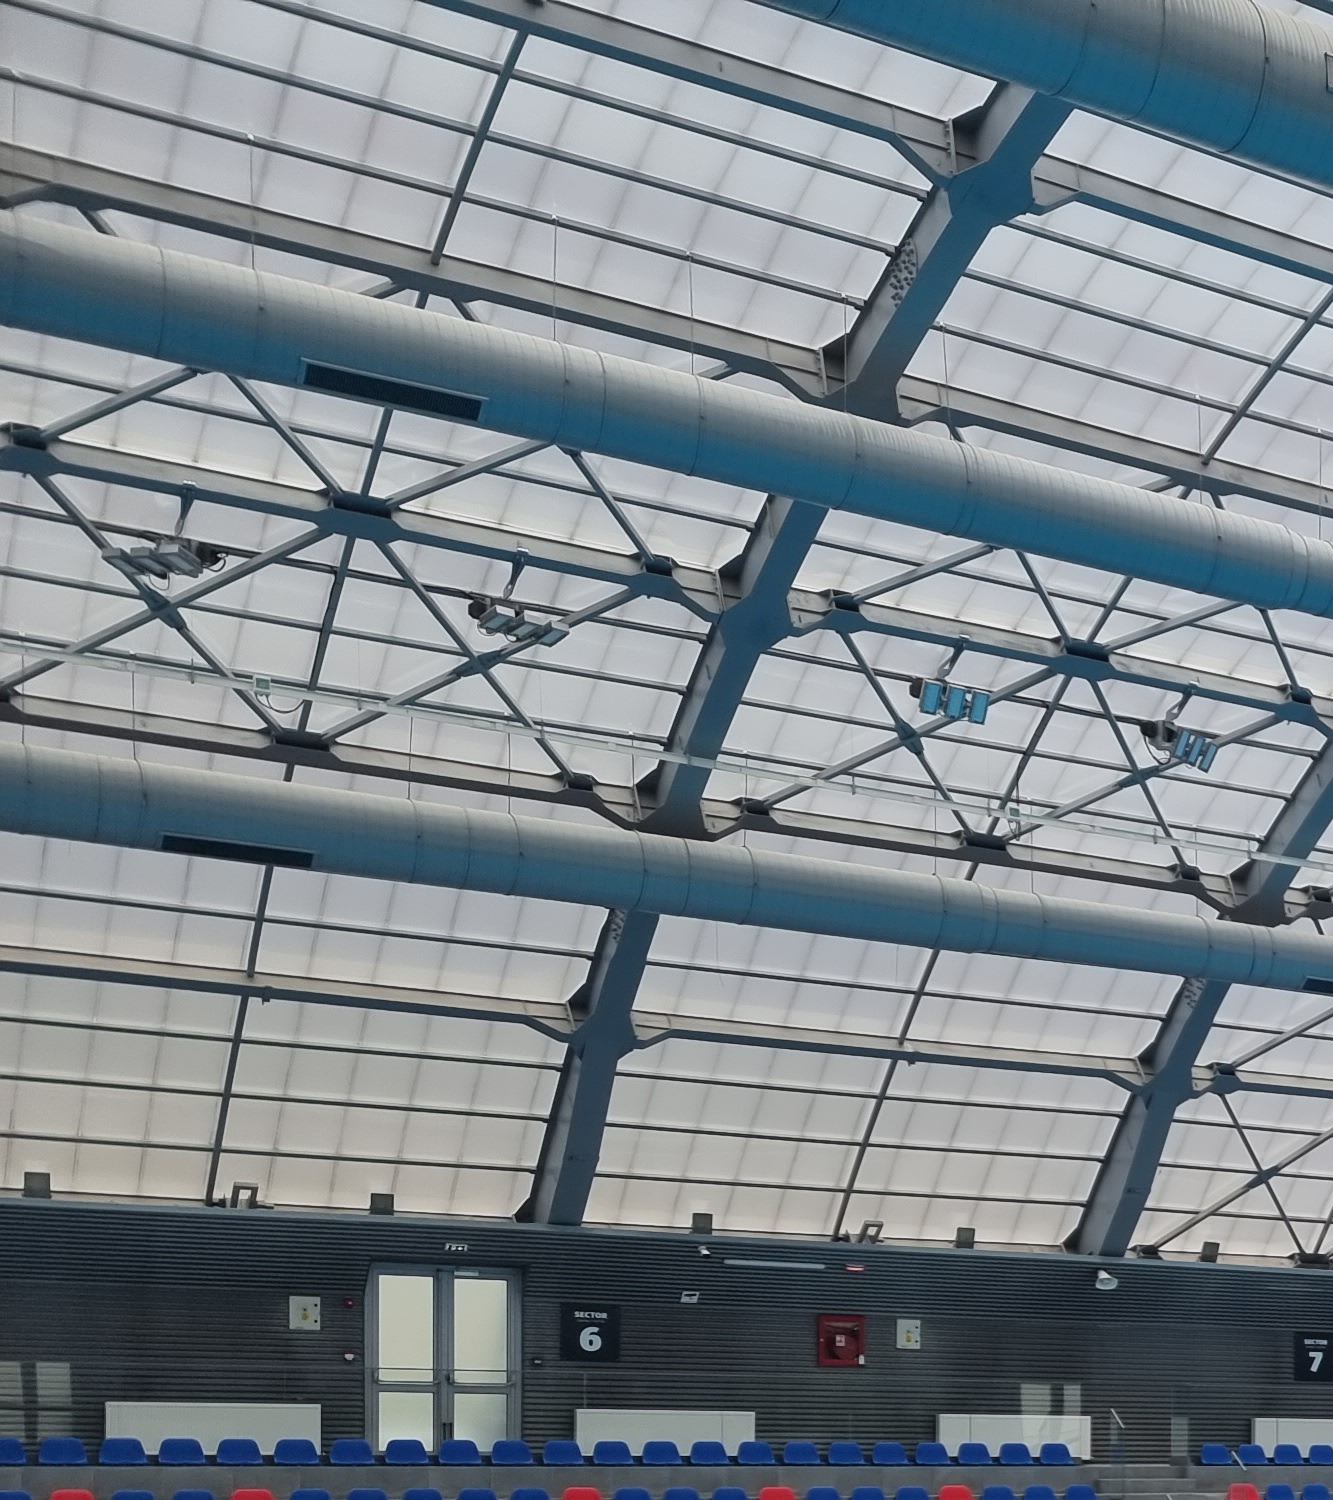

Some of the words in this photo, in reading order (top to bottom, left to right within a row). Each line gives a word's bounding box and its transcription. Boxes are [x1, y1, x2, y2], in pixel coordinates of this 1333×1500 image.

[574, 1311, 608, 1319] SECTOR
[579, 1326, 602, 1352] 6
[1308, 1351, 1323, 1372] 7
